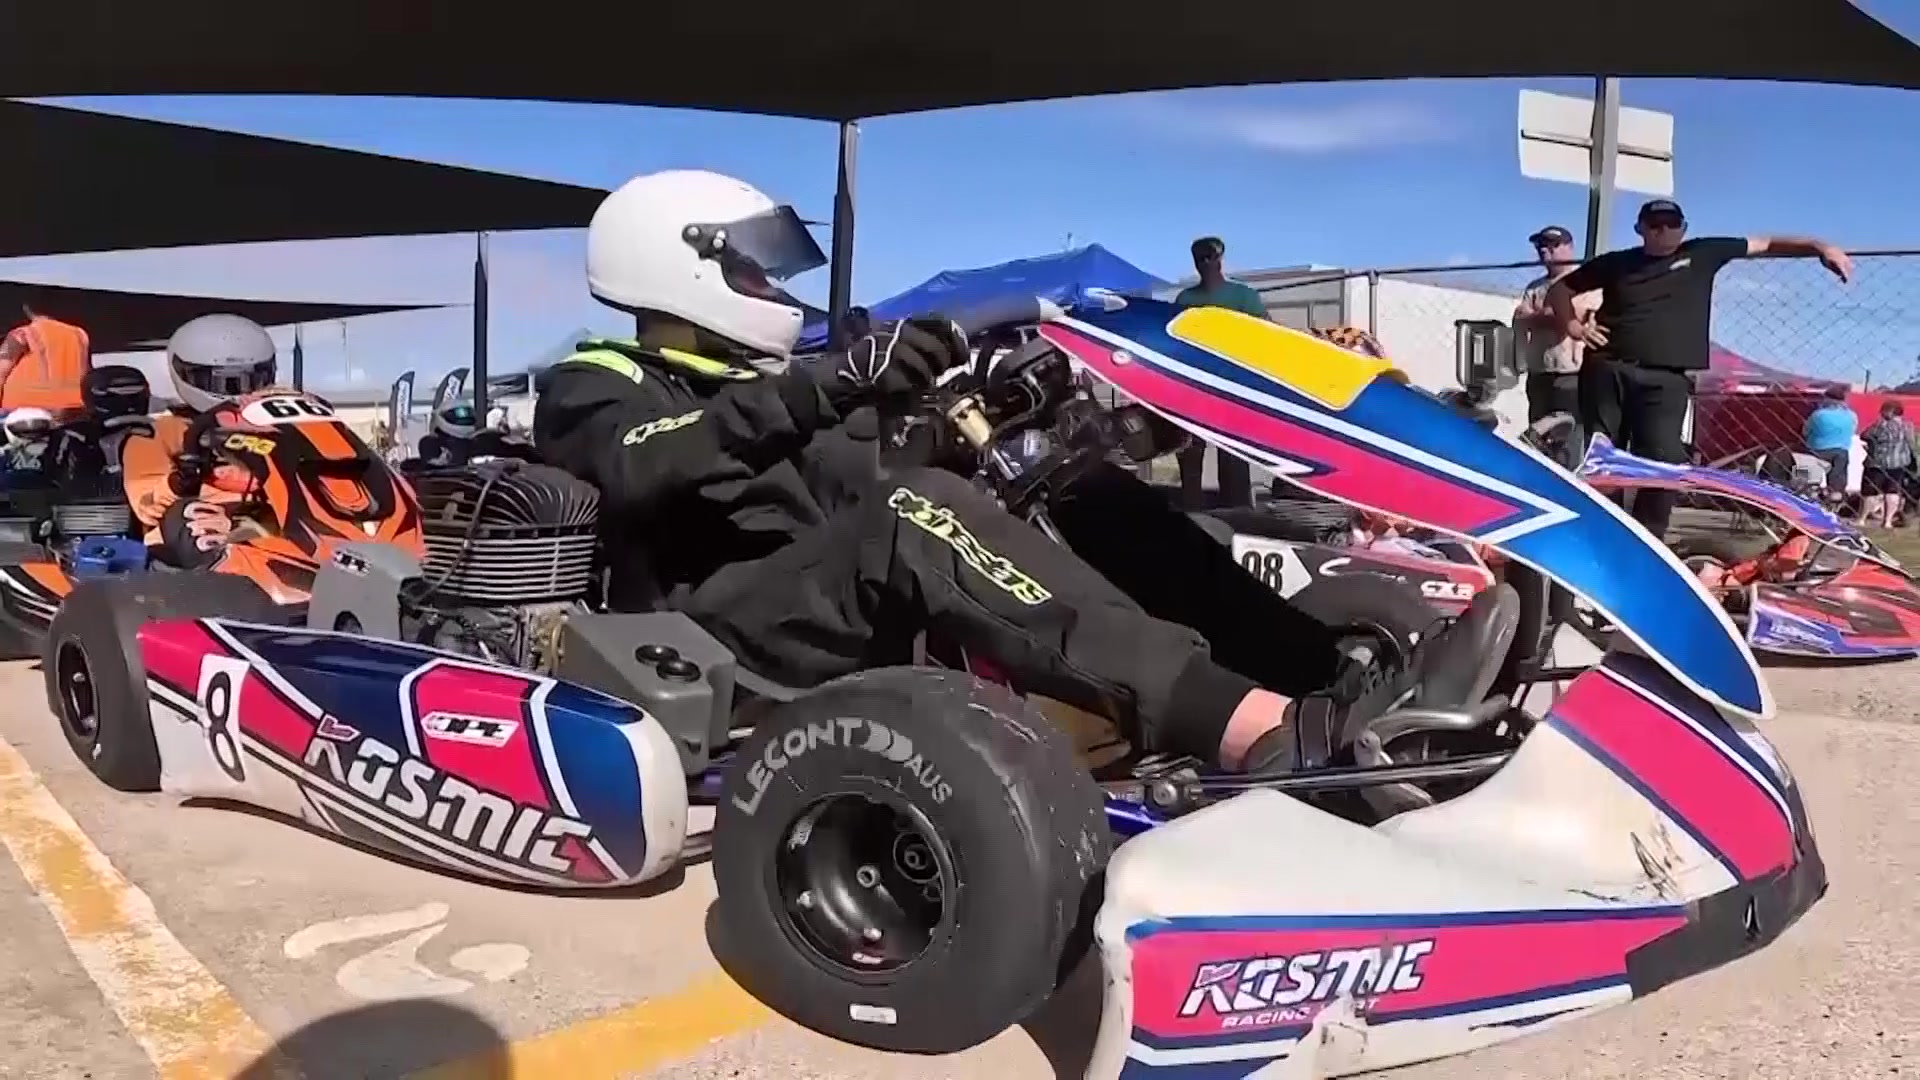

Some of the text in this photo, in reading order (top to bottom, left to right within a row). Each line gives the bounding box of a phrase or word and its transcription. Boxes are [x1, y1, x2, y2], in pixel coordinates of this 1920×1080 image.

[261, 399, 334, 418] 66
[206, 671, 246, 783] 8
[732, 717, 953, 816] LECONT AUS
[303, 714, 594, 872] KOSMIC
[1177, 937, 1436, 1018] KOSMIC
